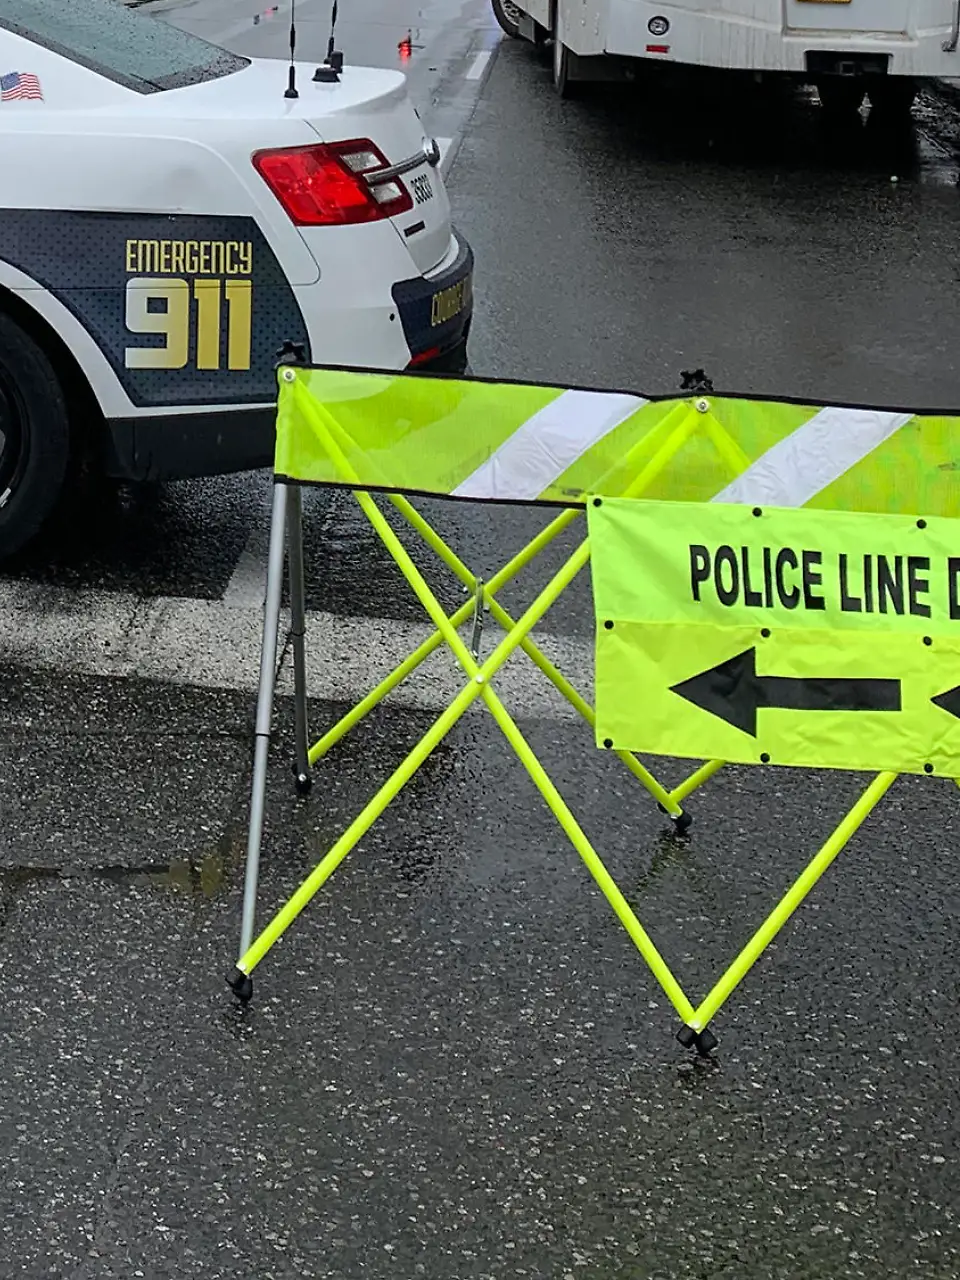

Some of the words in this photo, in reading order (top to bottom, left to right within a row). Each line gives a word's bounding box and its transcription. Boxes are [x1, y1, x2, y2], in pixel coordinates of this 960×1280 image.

[125, 239, 253, 274] EMERGENCY
[125, 277, 253, 370] 911
[689, 544, 826, 612] POLICE
[839, 553, 931, 618] LINE
